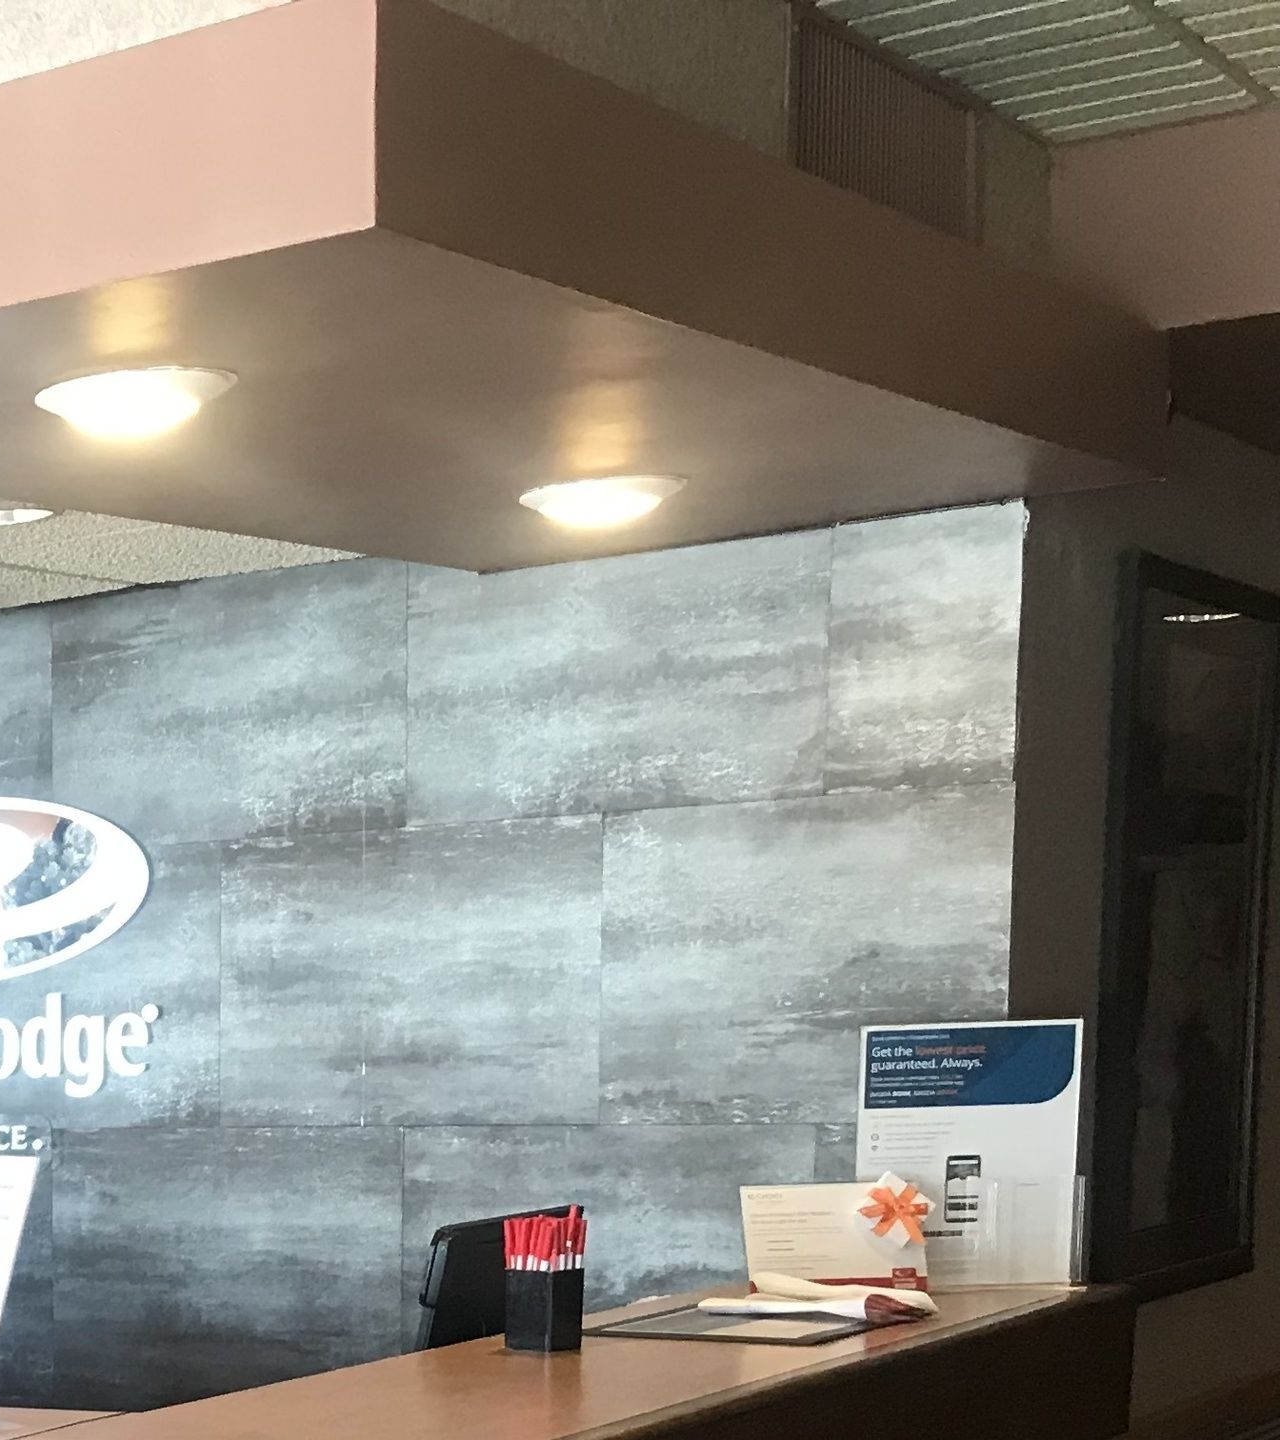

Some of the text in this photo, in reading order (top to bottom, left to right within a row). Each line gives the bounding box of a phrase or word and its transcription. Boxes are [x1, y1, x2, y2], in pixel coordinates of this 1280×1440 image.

[871, 1046, 892, 1058] Get
[894, 1045, 913, 1057] the
[870, 1057, 983, 1073] guaranteed. Always.
